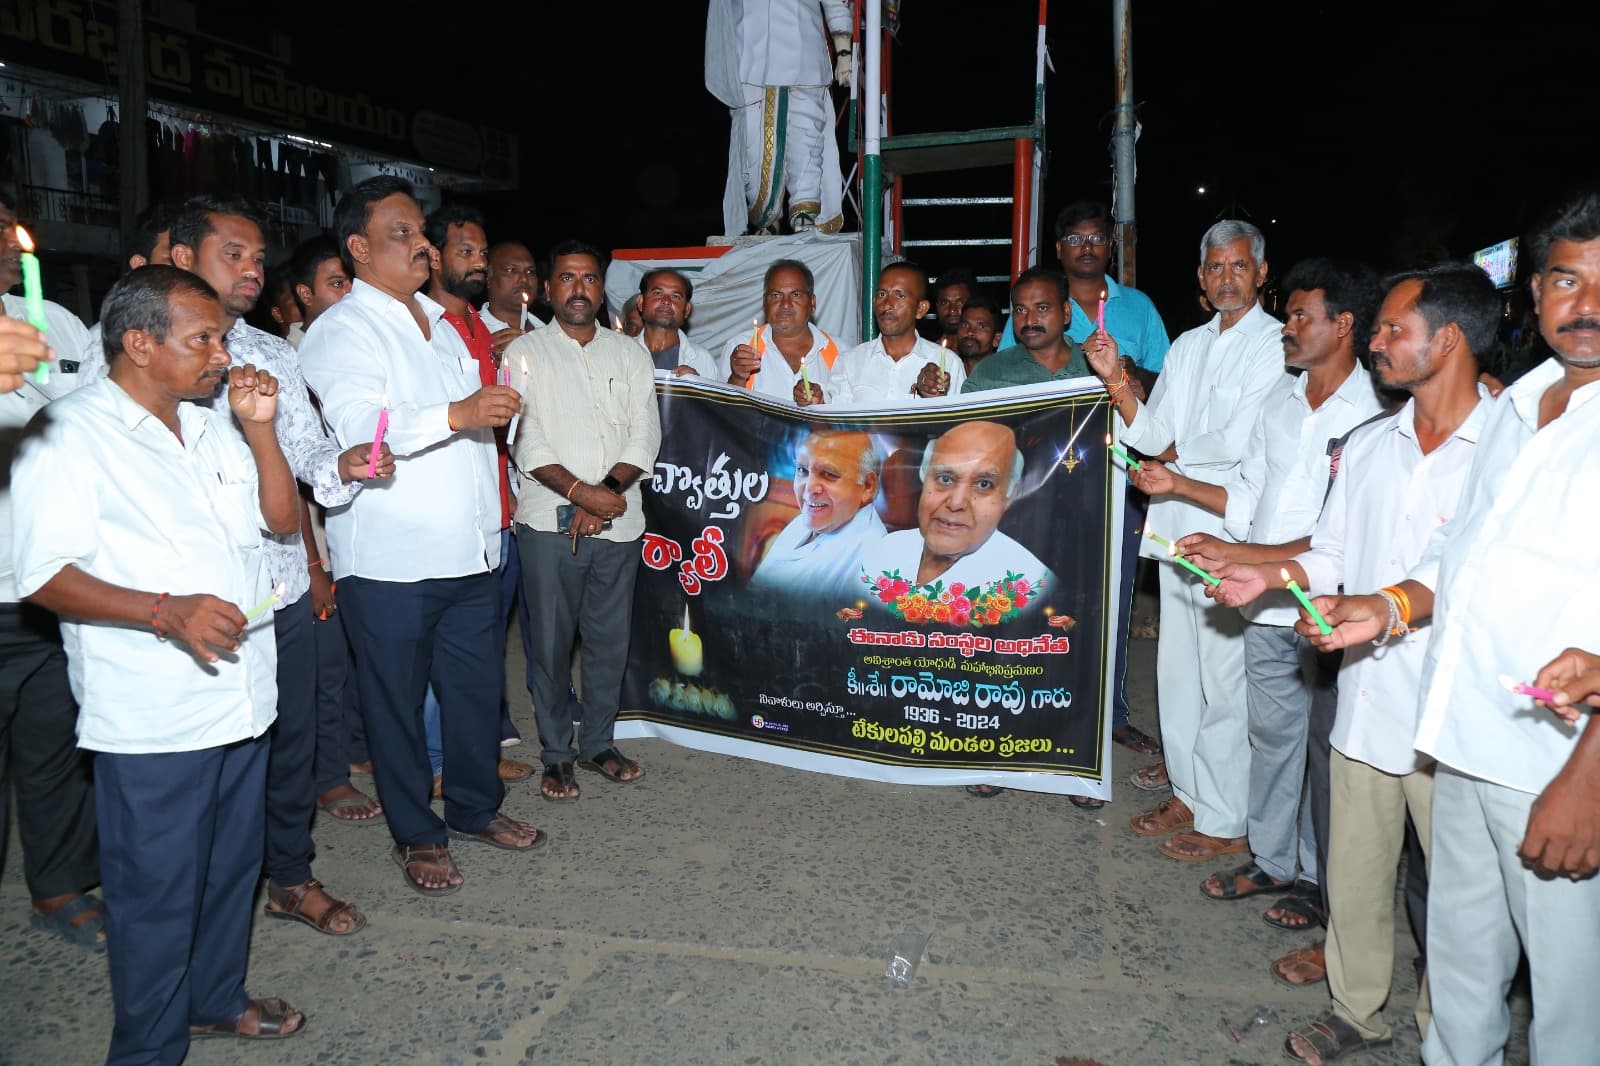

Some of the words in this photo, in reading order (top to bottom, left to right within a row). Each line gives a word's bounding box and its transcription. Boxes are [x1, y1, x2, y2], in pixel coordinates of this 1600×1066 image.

[847, 627, 925, 648] ఈనాడు
[928, 631, 991, 657] సంస్థల
[995, 635, 1070, 656] అధినేత
[974, 681, 1027, 716] రావు
[1031, 688, 1072, 709] గారు
[903, 705, 940, 724] 1936
[956, 713, 1001, 730] 2024
[851, 718, 927, 756] టేకులపల్లి
[930, 731, 995, 753] మండల
[998, 734, 1053, 758] ప్రజలు
